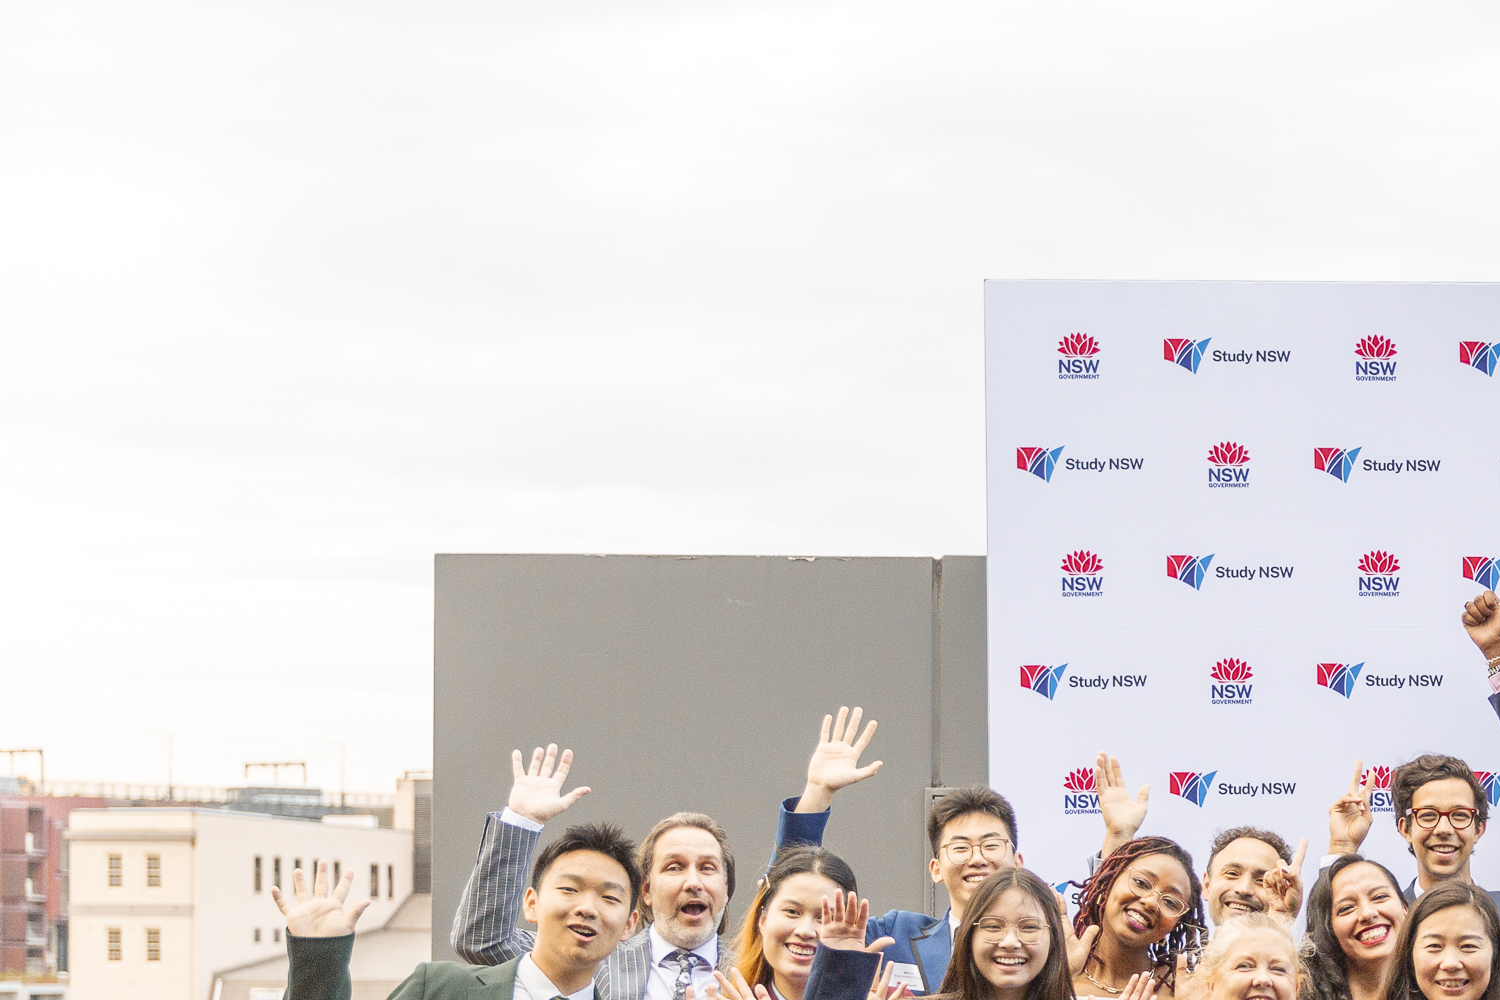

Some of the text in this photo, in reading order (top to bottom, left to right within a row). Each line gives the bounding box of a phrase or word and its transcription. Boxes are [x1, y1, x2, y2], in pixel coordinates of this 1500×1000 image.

[1212, 349, 1292, 365] Study NSW
[1058, 358, 1101, 374] NSW
[1355, 360, 1398, 376] NSW
[1065, 457, 1144, 473] Study NSW
[1362, 458, 1441, 474] Study NSW
[1208, 467, 1250, 483] NSW
[1215, 565, 1295, 581] Study NSW
[1061, 576, 1104, 592] NSW
[1358, 576, 1400, 592] NSW
[1068, 674, 1148, 690] Study NSW
[1365, 674, 1444, 690] Study NSW
[1211, 684, 1253, 699] NSW
[1218, 782, 1297, 798] Study NSW
[1064, 794, 1102, 809] NSW
